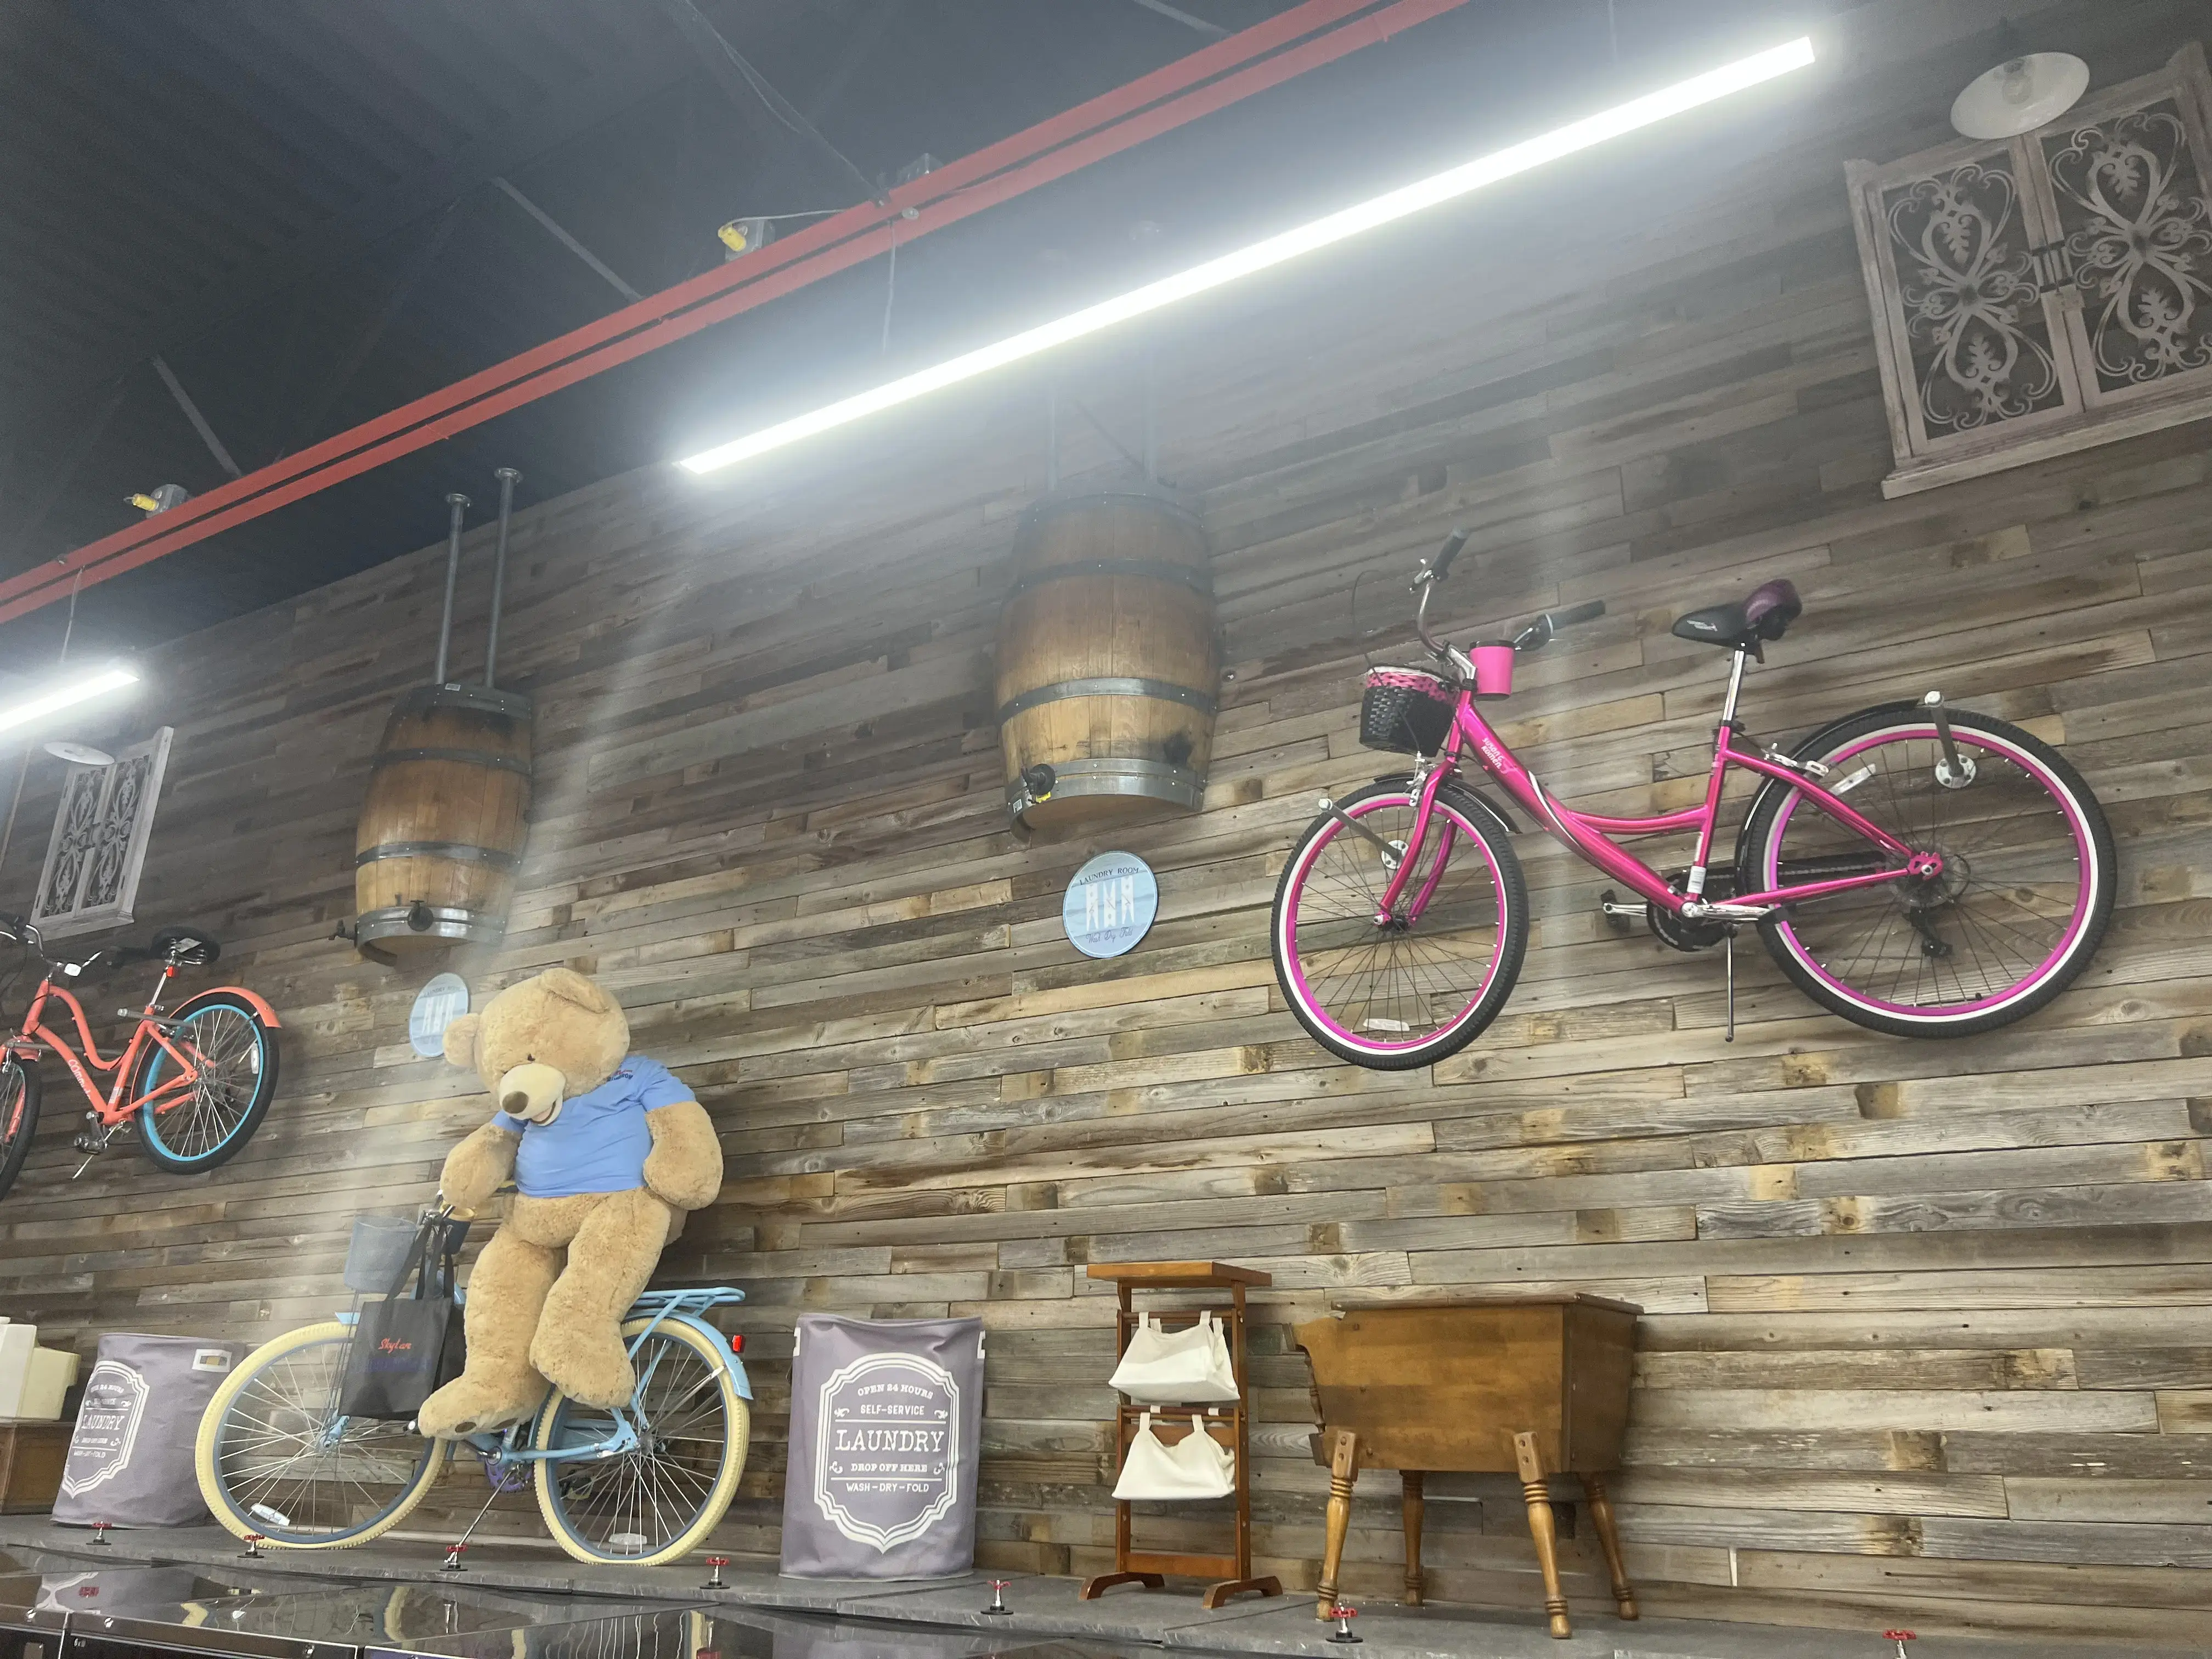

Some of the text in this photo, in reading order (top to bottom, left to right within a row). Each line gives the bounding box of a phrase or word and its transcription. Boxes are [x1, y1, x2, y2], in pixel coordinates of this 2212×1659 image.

[1079, 868, 1113, 885] LAUNDRY
[857, 1384, 934, 1400] OPEN 24 HOURS
[860, 1404, 925, 1415] SELF-SERVICE
[835, 1429, 945, 1453] LAUNDRY
[851, 1463, 928, 1473] DROP OFF HERE
